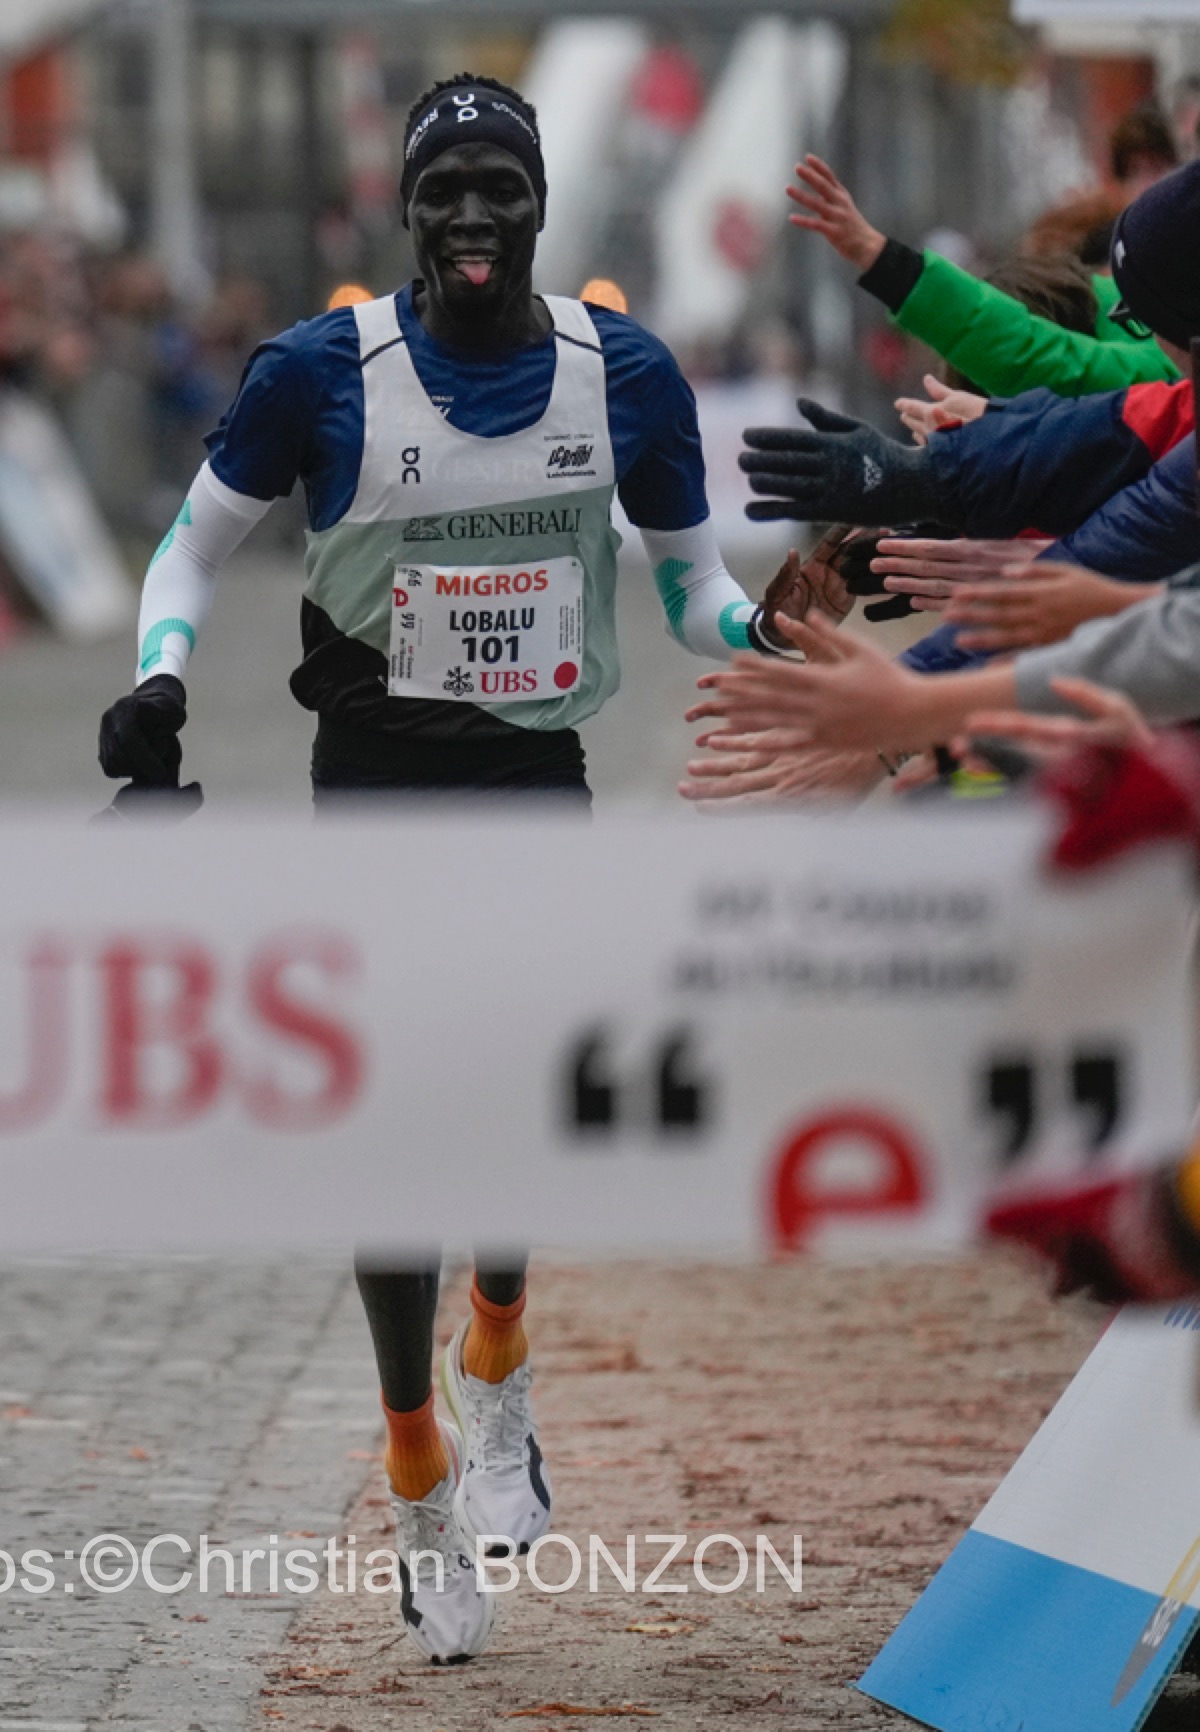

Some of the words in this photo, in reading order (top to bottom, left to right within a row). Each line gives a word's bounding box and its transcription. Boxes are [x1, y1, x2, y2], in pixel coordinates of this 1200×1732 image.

[447, 508, 583, 541] GENERALI
[435, 569, 549, 597] MIGROS
[449, 606, 535, 633] LOBALU
[461, 635, 519, 664] 101
[480, 668, 538, 695] UBS
